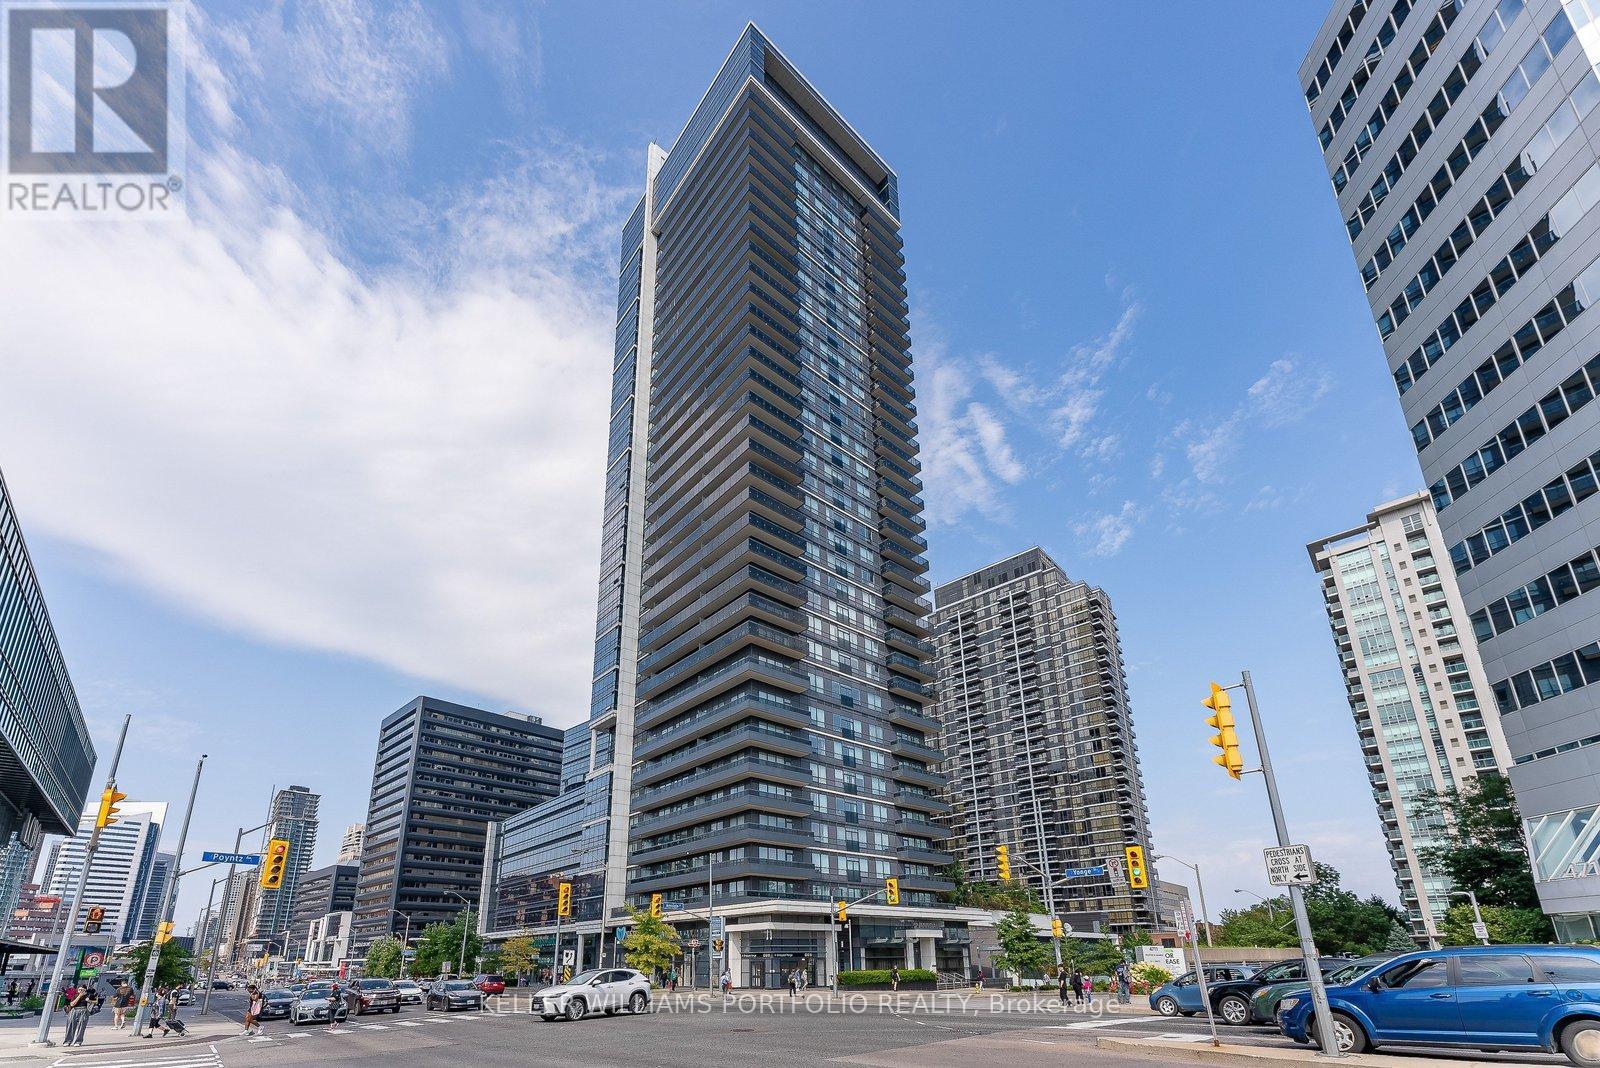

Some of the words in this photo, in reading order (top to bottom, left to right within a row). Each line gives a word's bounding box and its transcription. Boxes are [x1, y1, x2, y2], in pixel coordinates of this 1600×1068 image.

[1266, 847, 1304, 858] PEDESTRIANS
[212, 853, 244, 863] Poyntz
[1271, 858, 1290, 866] CROSS
[1294, 856, 1302, 864] AT
[1270, 866, 1289, 874] NORTH
[1293, 864, 1307, 872] SIDE
[1271, 875, 1287, 883] ONLY
